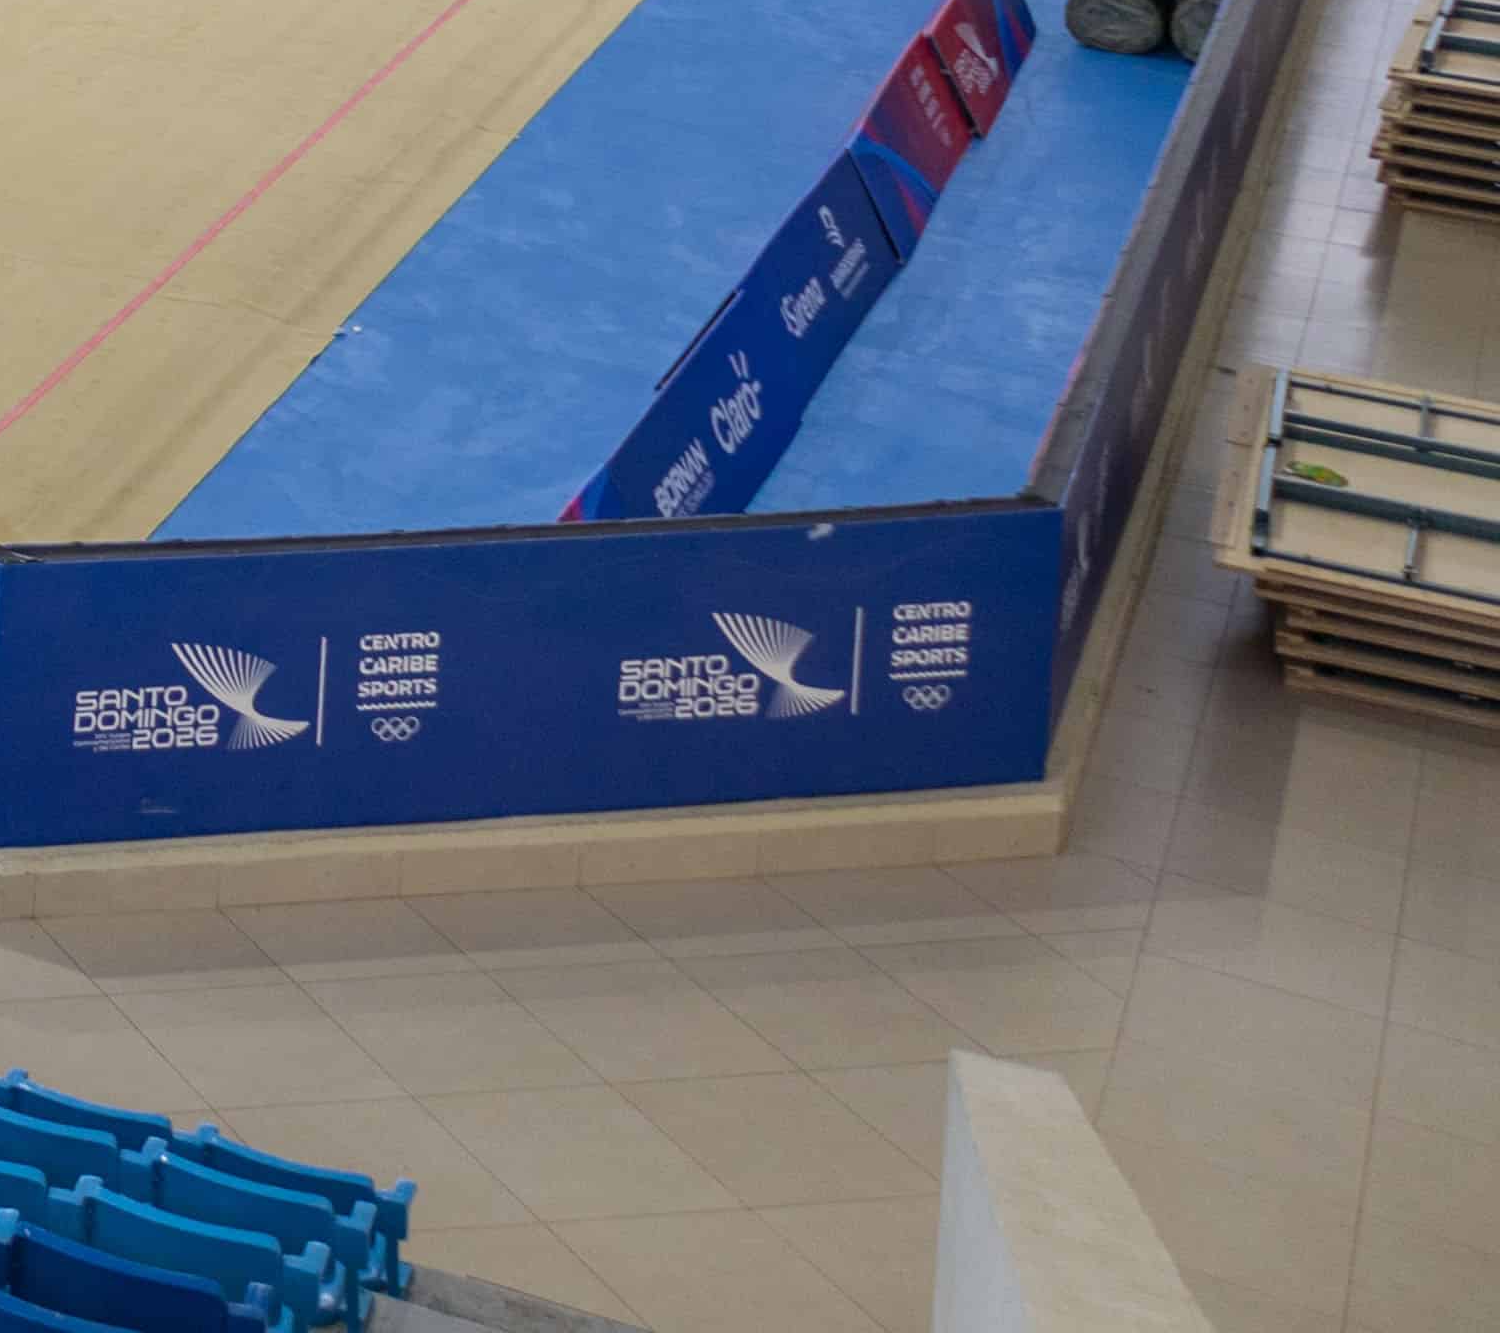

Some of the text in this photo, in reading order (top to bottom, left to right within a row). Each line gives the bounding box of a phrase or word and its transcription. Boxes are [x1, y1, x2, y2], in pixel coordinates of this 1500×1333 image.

[710, 379, 762, 454] Claro
[893, 601, 972, 620] CENTRO
[359, 631, 441, 652] CENTRO
[892, 624, 969, 644] CARIBE
[359, 654, 439, 675] CARIBE
[620, 654, 729, 680] SANTO
[891, 647, 967, 667] SPORTS
[75, 685, 187, 712] SANTO
[357, 678, 437, 698] SPORTS
[618, 673, 760, 702] DOMINGO
[675, 695, 759, 718] 2026
[73, 703, 220, 733] DOMINGO
[132, 728, 217, 750] 2026
